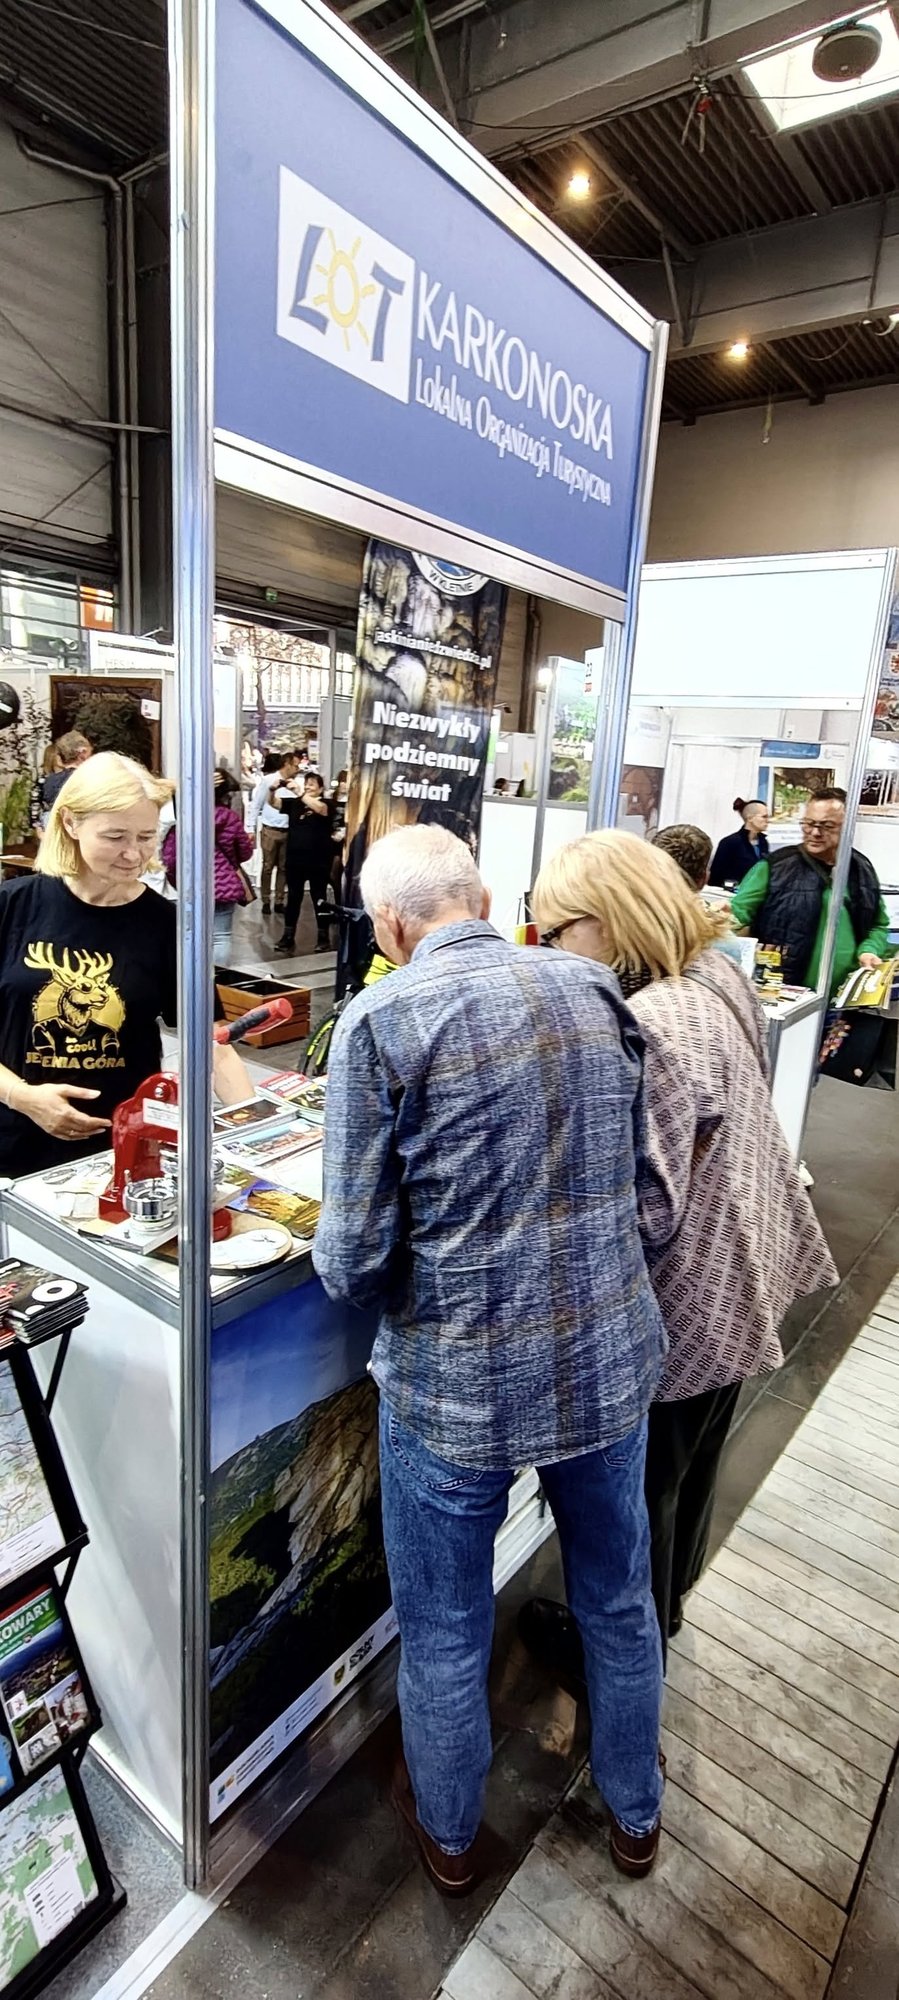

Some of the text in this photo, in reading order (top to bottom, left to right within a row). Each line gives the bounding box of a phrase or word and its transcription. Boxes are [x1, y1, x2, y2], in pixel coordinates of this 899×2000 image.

[289, 223, 406, 362] LOT
[417, 270, 614, 461] KARKONOSKA
[372, 701, 481, 744] Niezwykły
[365, 741, 481, 777] podziemny
[391, 775, 452, 802] świat
[25, 1051, 126, 1070] JEENIA GÓRA
